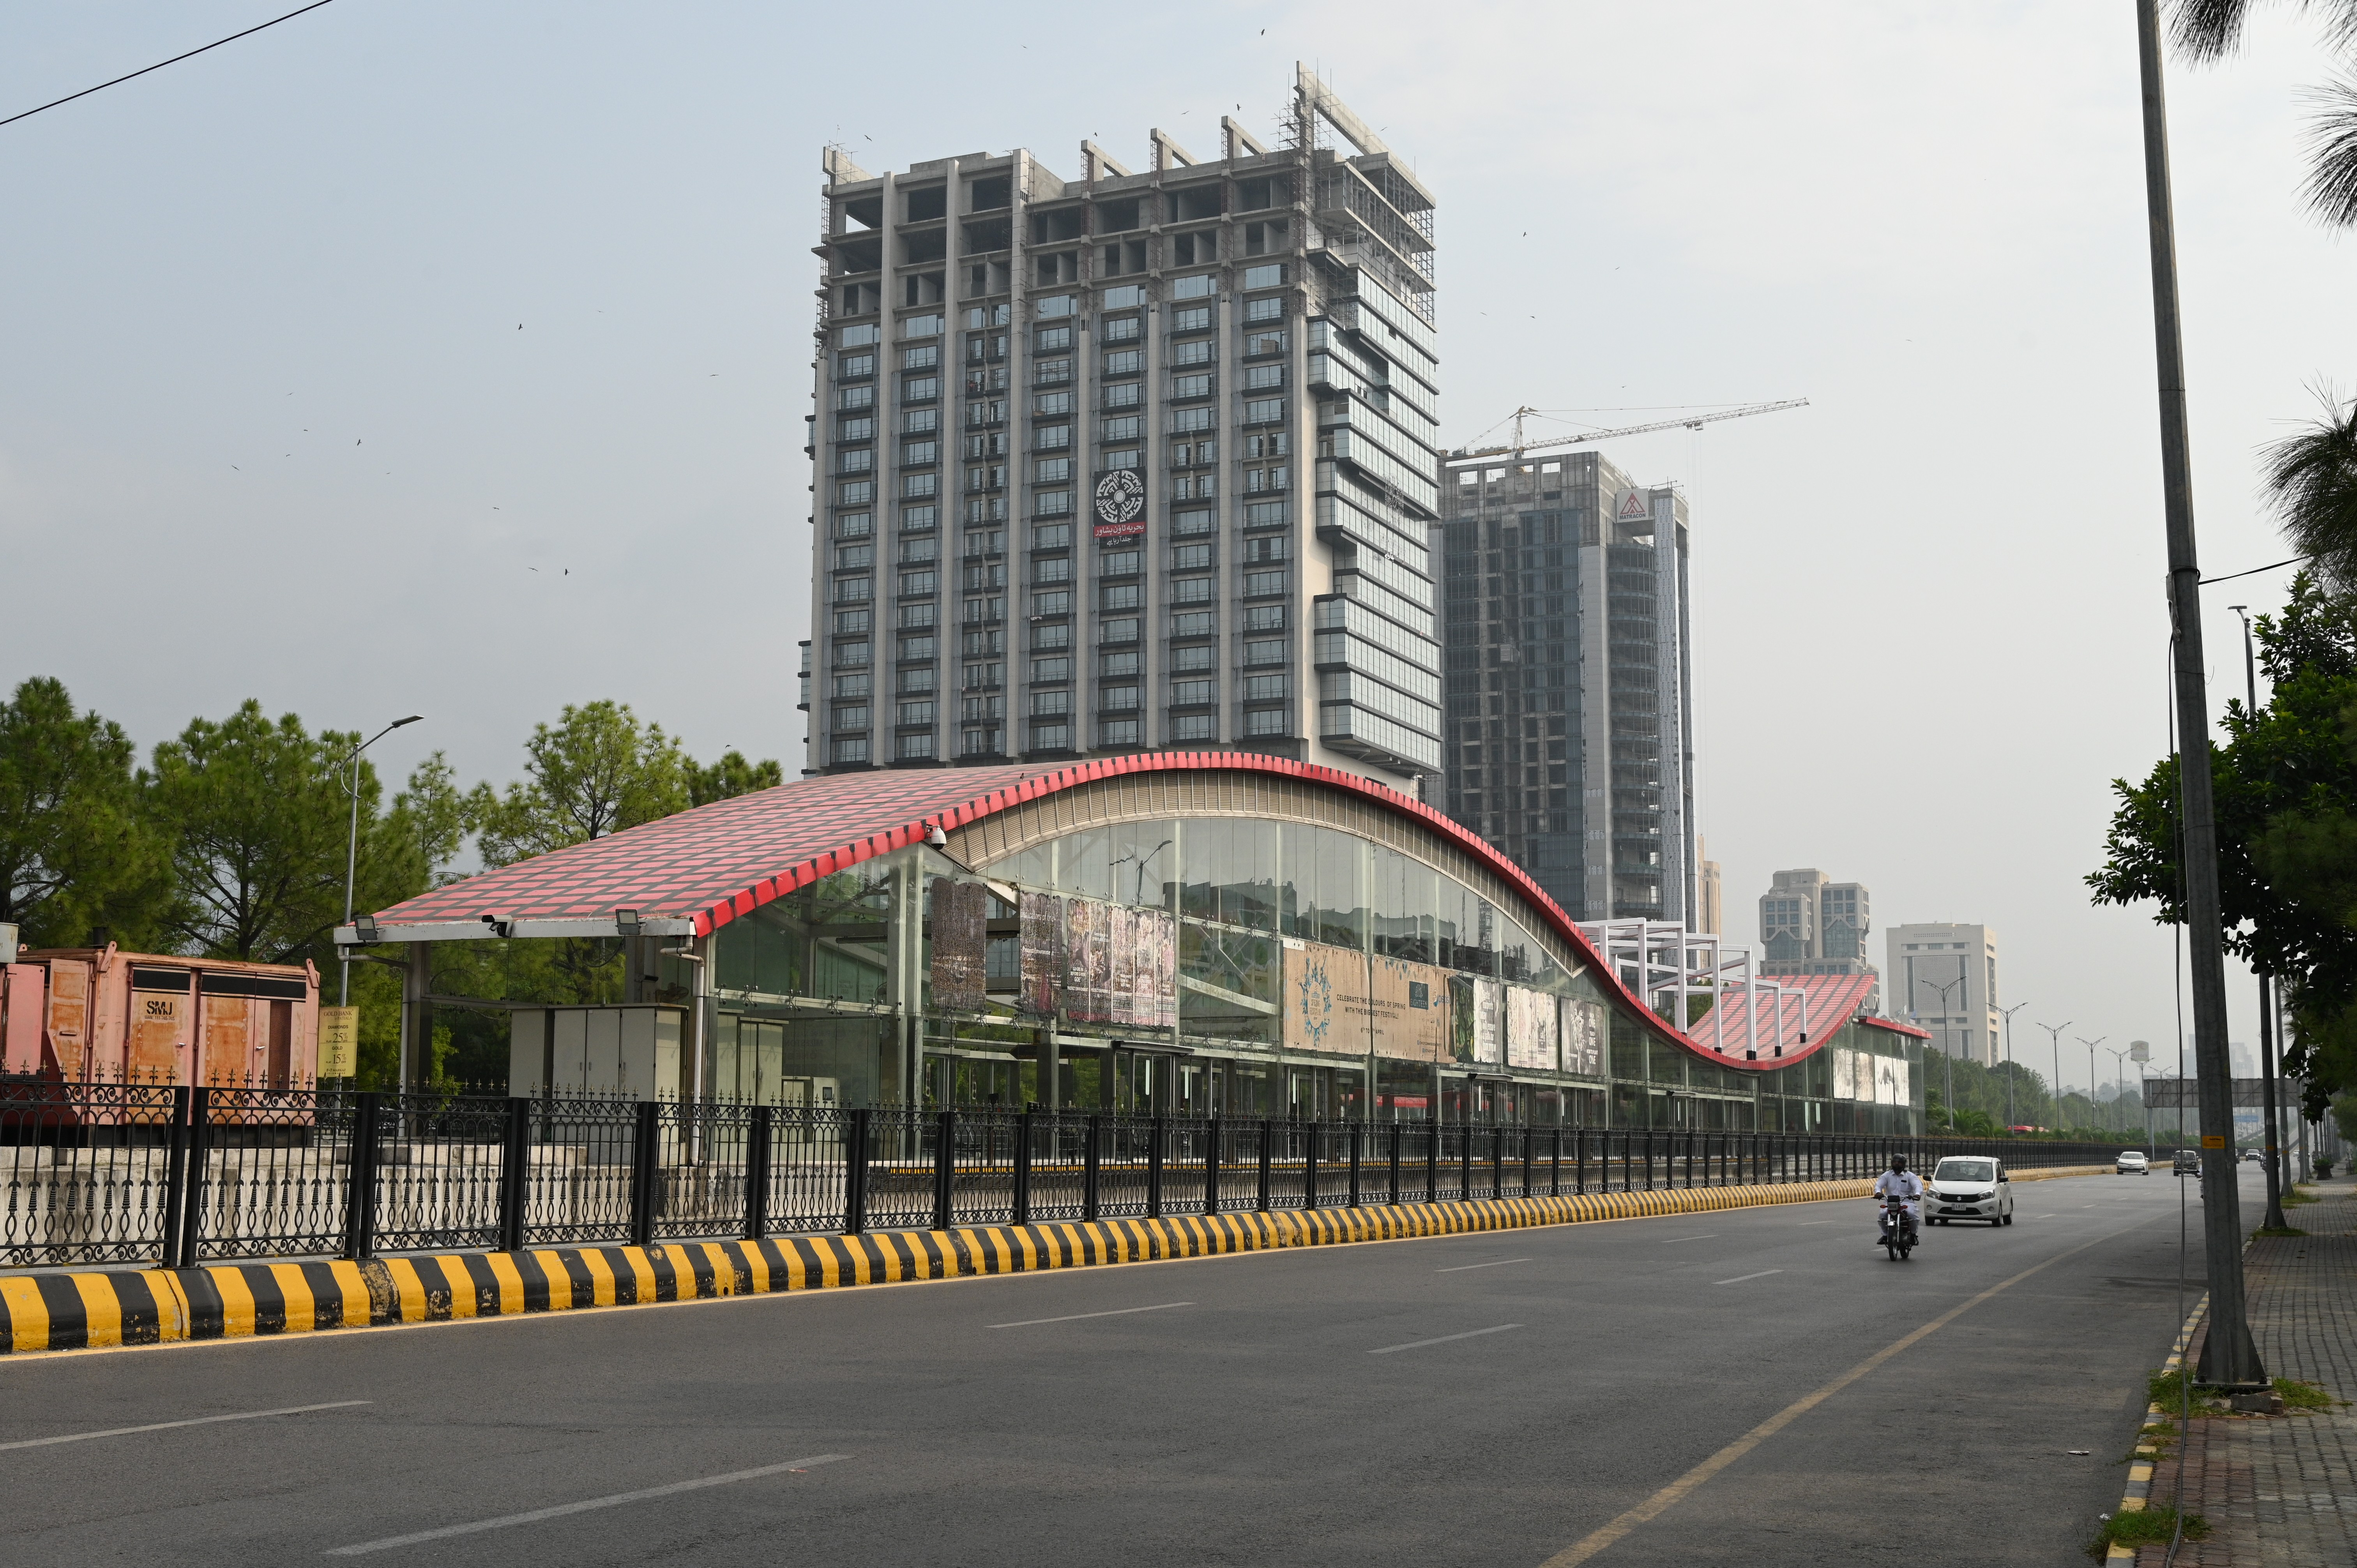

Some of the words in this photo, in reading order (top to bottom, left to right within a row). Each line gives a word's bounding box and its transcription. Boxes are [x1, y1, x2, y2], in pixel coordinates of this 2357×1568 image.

[1095, 526, 1113, 536] پشاور
[1337, 994, 1359, 1003] CELEBRATE
[1410, 998, 1428, 1008] EIGHTEEN
[147, 1001, 172, 1015] SMJ
